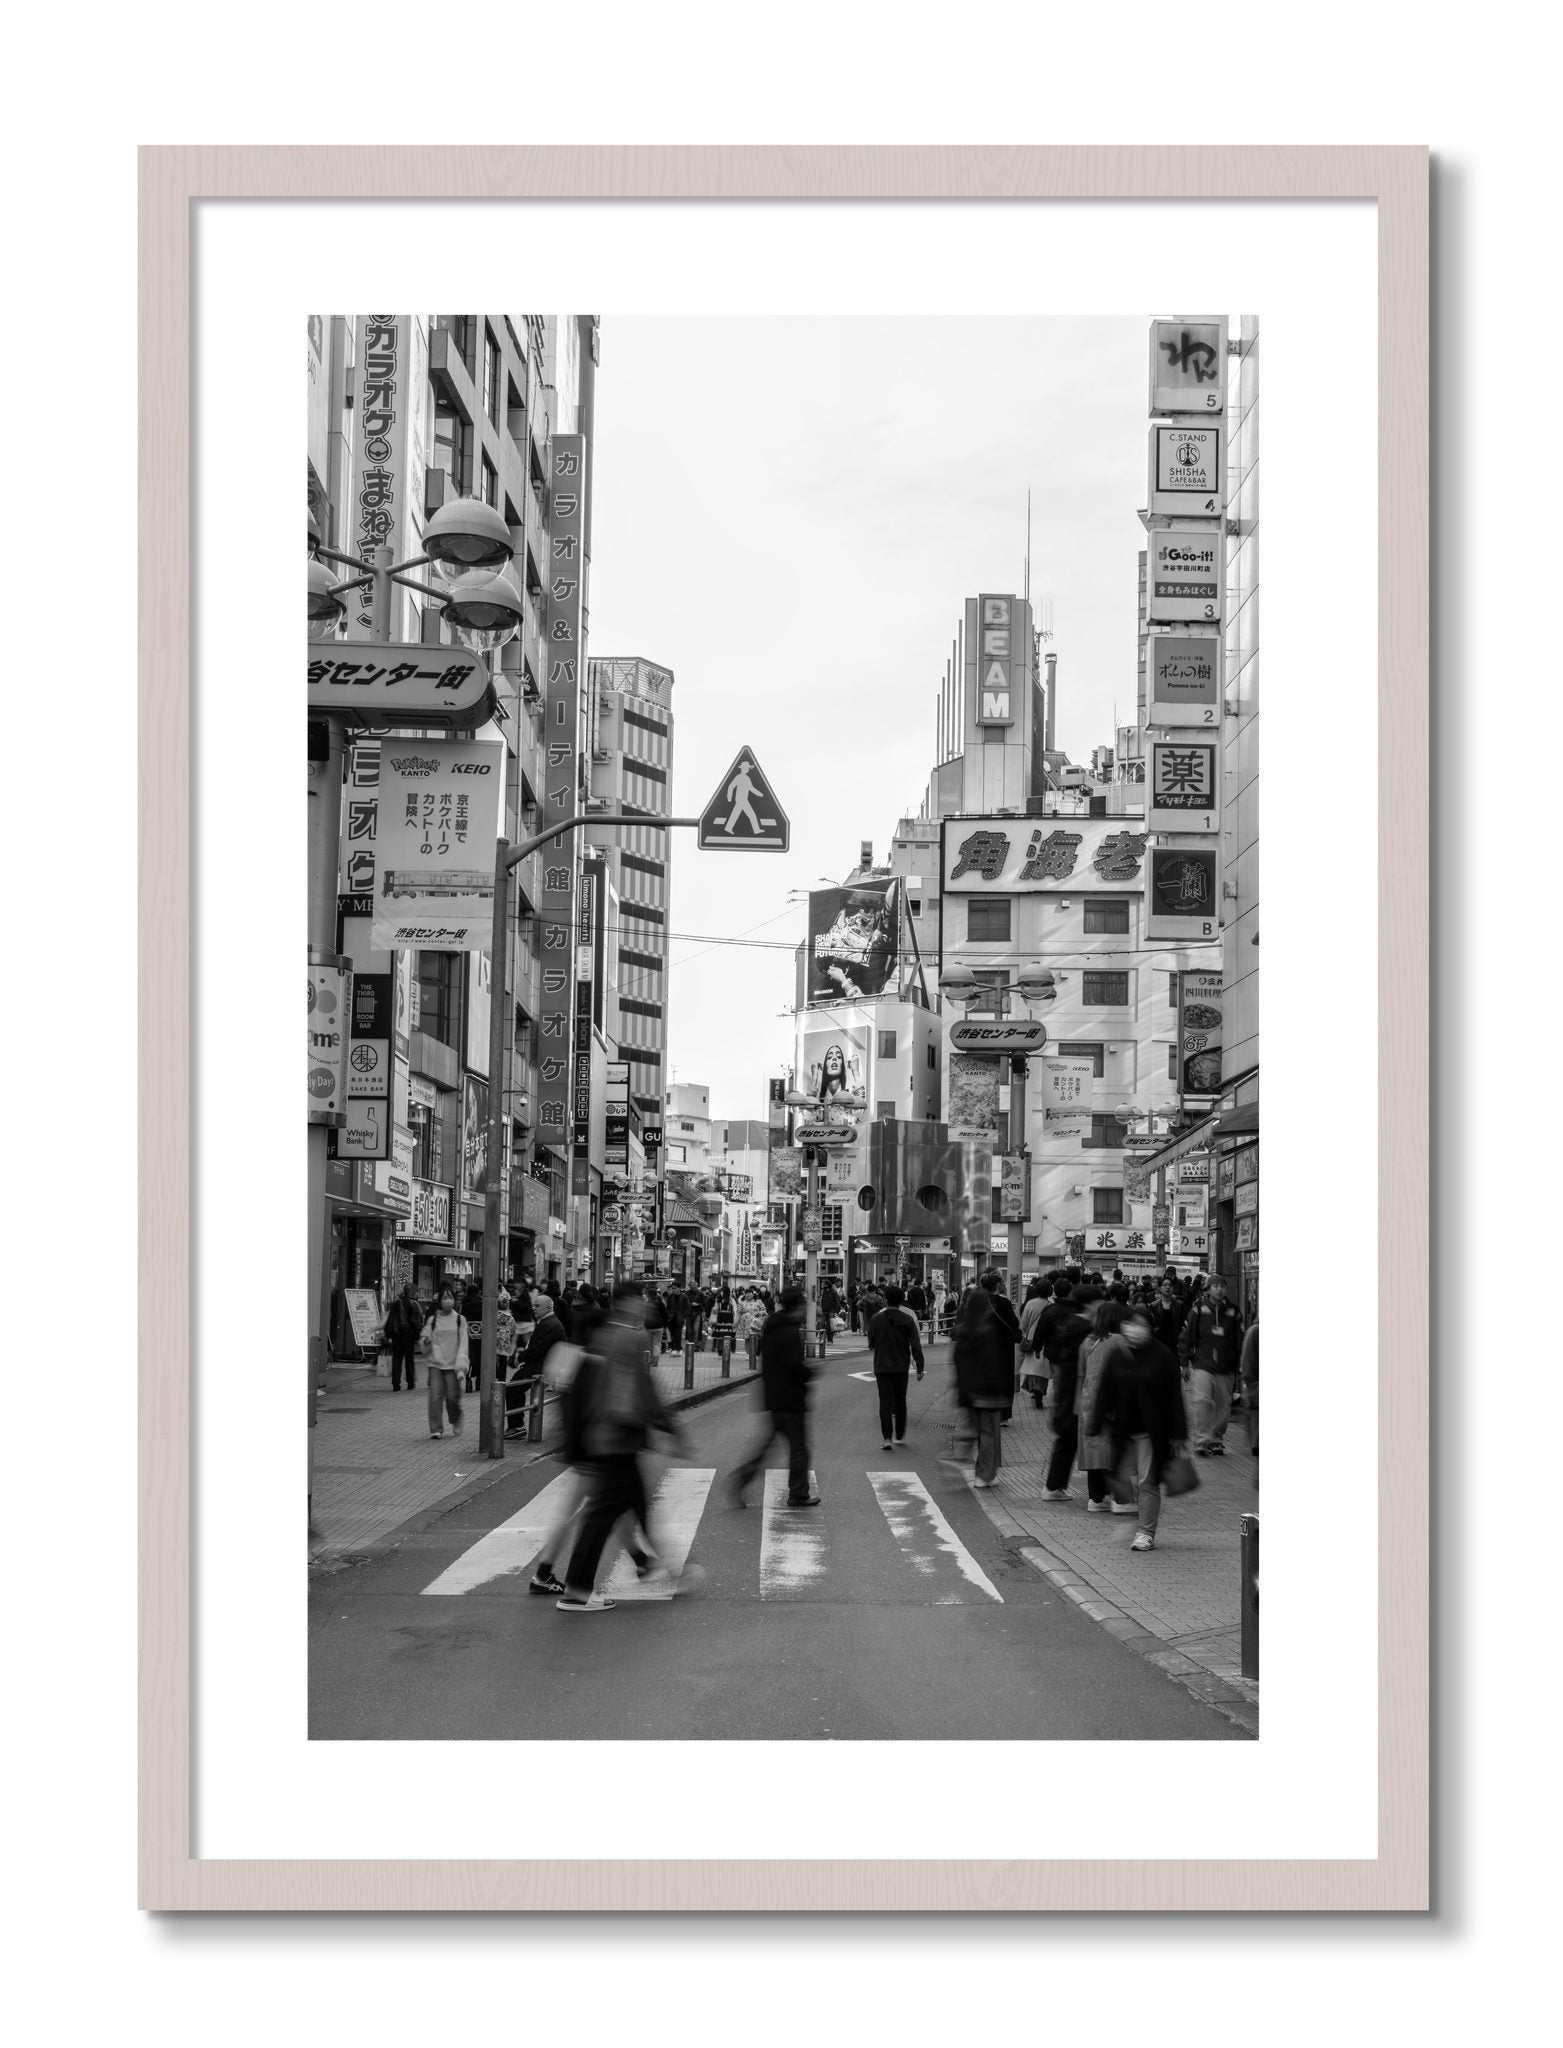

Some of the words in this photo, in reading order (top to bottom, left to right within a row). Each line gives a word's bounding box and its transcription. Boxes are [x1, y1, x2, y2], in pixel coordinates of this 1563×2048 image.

[363, 324, 397, 438] カラオケ
[1206, 395, 1216, 407] 5
[1169, 434, 1207, 442] C.STAND
[1169, 468, 1206, 476] SHISHA
[1205, 500, 1215, 512] 4
[1168, 549, 1214, 561] Goo-it!
[1158, 586, 1214, 596] 全身もみほぐし
[1204, 604, 1214, 618] 3
[983, 599, 1009, 718] BEAM
[1204, 710, 1214, 723] 2
[451, 764, 491, 775] KEIO
[1161, 750, 1204, 792] 薬
[405, 793, 418, 828] 冒険へ
[420, 794, 434, 855] カントーの
[455, 794, 469, 843] 京王線で
[1203, 816, 1210, 829] 1
[951, 830, 1150, 880] 角海老
[395, 928, 467, 939] 渋谷センター街
[1203, 922, 1212, 935] B
[956, 1028, 1041, 1039] 渋谷センター街
[1184, 1036, 1208, 1053] 6F
[346, 1129, 374, 1138] Whisky
[644, 1132, 661, 1141] GU
